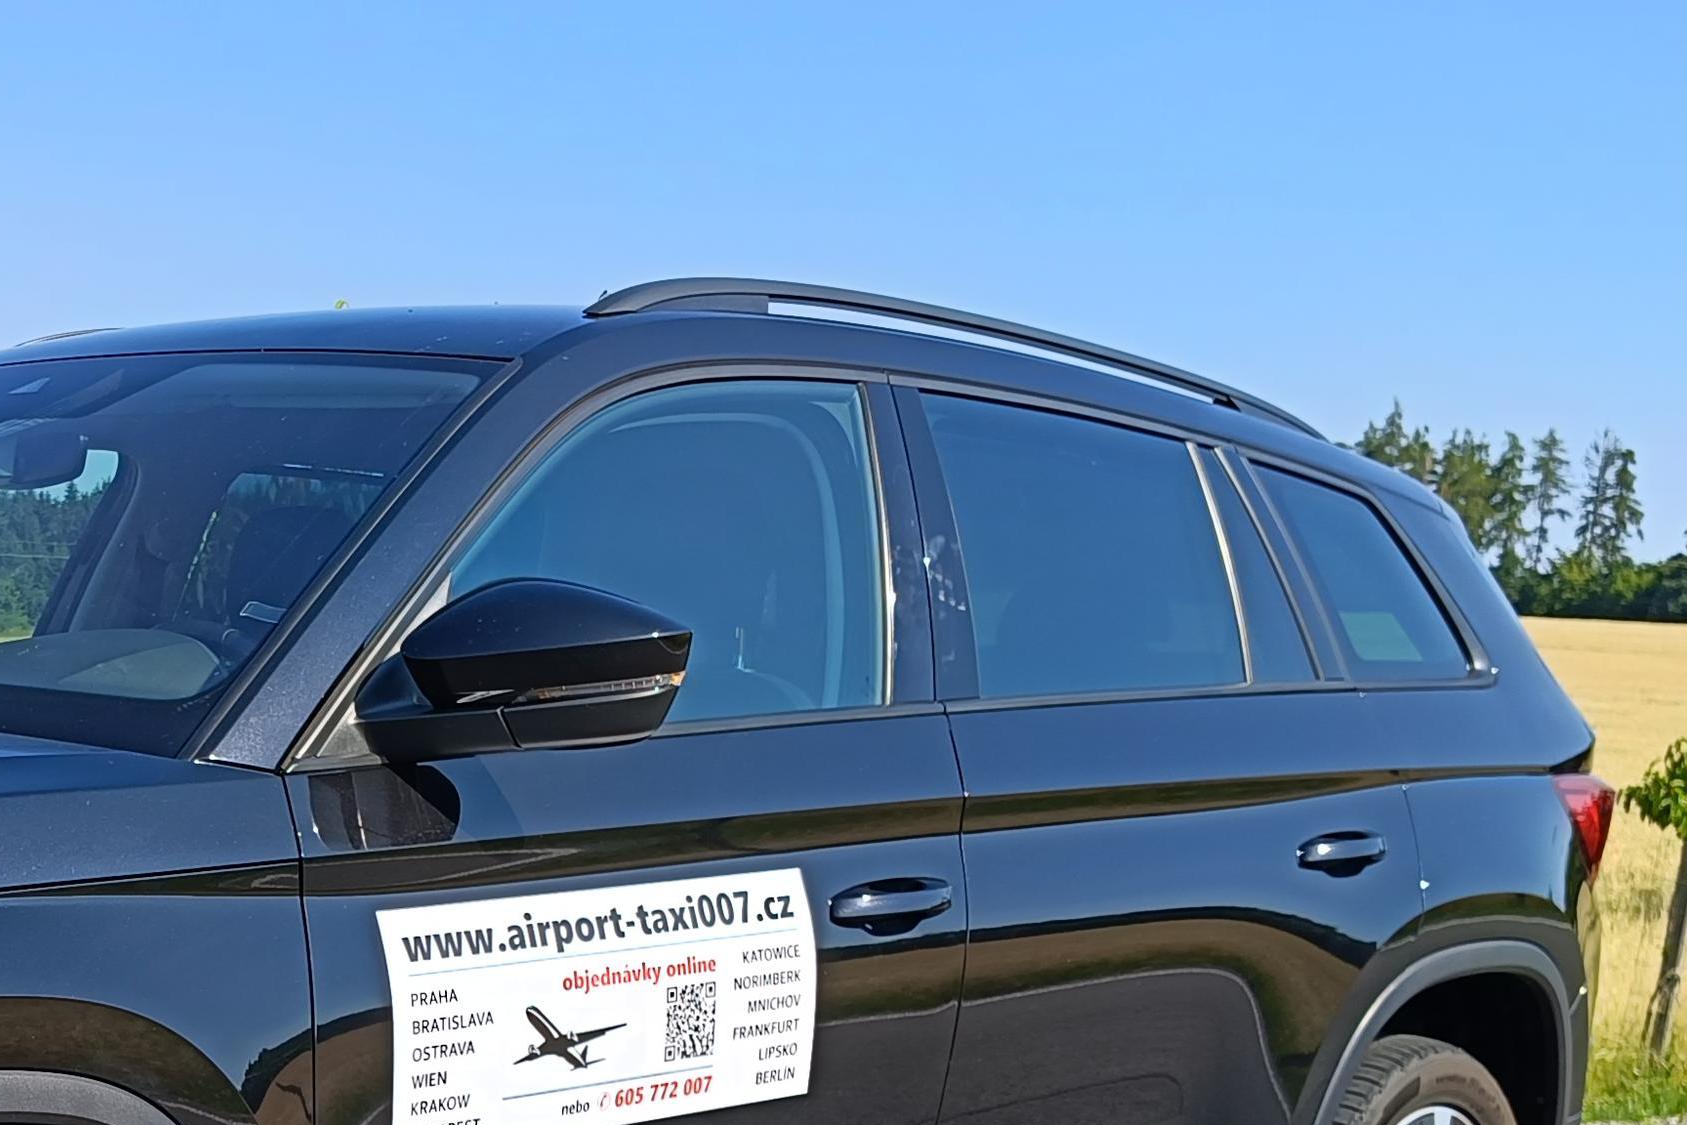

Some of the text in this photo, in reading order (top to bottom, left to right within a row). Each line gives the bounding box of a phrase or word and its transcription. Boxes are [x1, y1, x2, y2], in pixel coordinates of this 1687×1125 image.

[402, 891, 794, 962] www.airport-taxi007.cz
[743, 945, 800, 963] KATOWICE
[563, 957, 716, 993] objednávky online
[734, 971, 800, 990] NORIMBERK
[411, 989, 458, 1007] PRAHA
[748, 995, 800, 1012] MNICHOV
[413, 1011, 493, 1035] BRATISLAVA
[733, 1019, 799, 1039] FRANKFURT
[413, 1041, 474, 1062] OSTRAVA
[759, 1043, 797, 1060] LIPSKO
[412, 1071, 447, 1089] WIEN
[411, 1094, 470, 1115] KRAKOW
[562, 1076, 712, 1115] nebo 605 772 007
